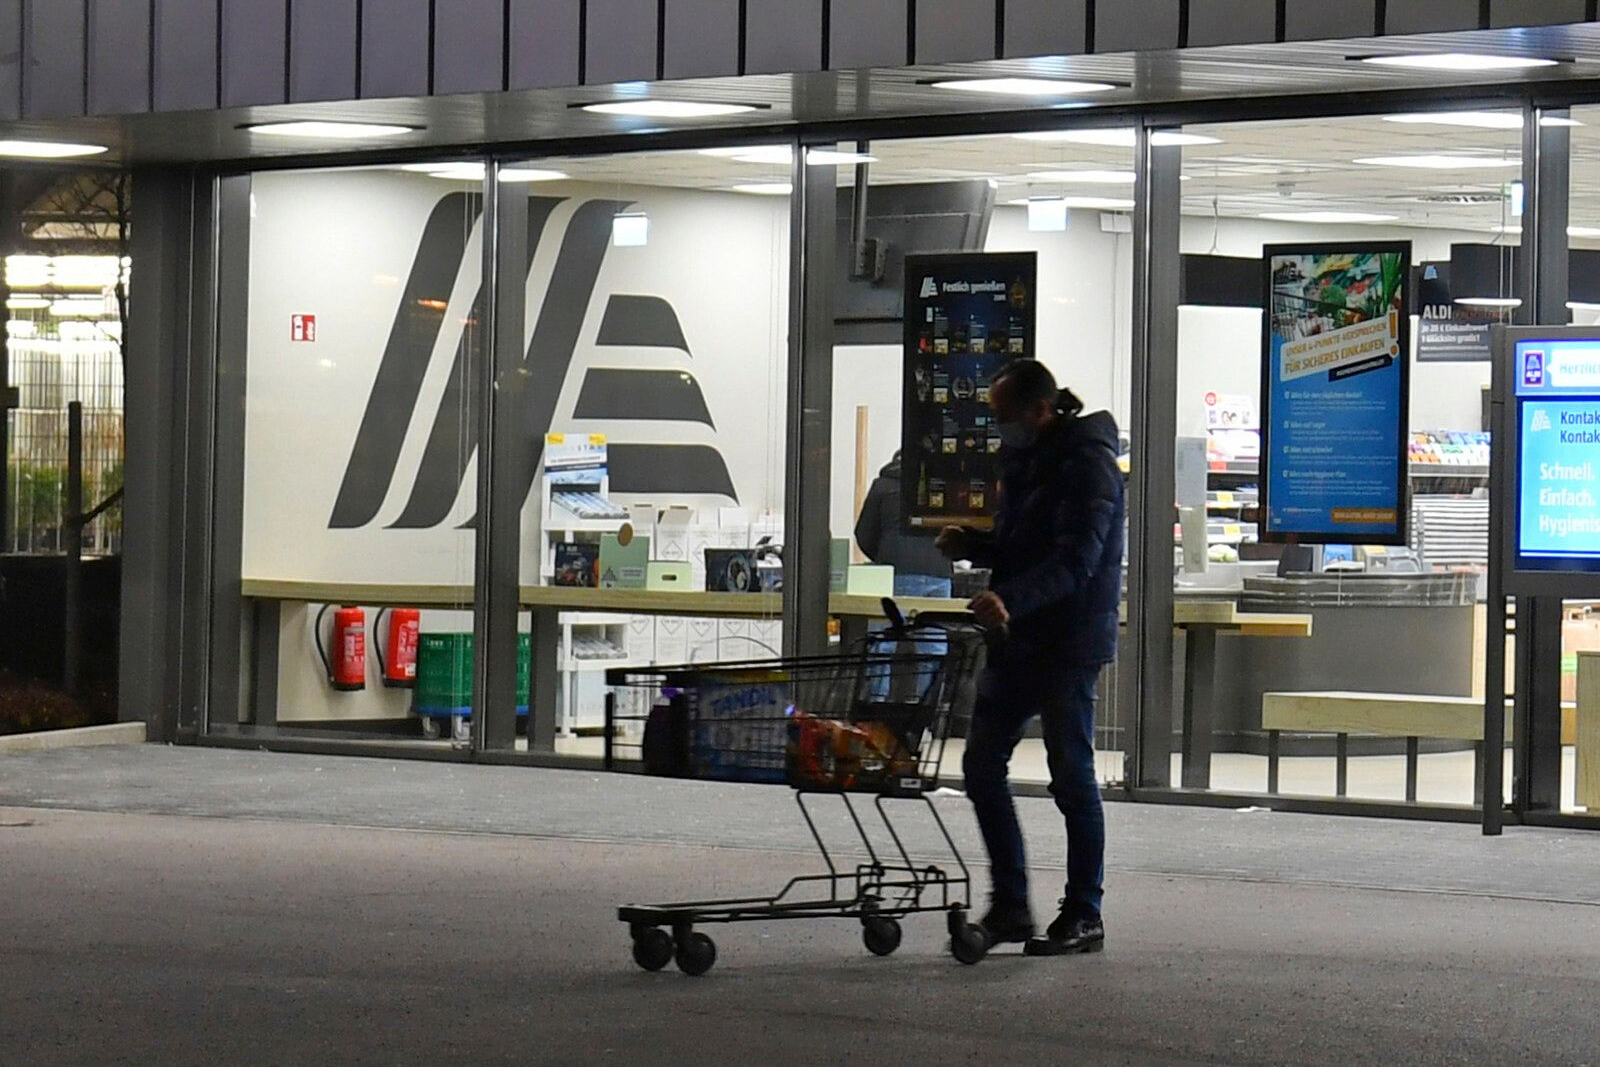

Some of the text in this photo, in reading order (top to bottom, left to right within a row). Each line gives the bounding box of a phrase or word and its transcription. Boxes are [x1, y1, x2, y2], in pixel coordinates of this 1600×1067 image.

[1285, 359, 1300, 374] FÜR
[1302, 350, 1339, 369] SICHERES
[1539, 460, 1595, 480] Schnell.
[1539, 488, 1596, 506] Einfach.
